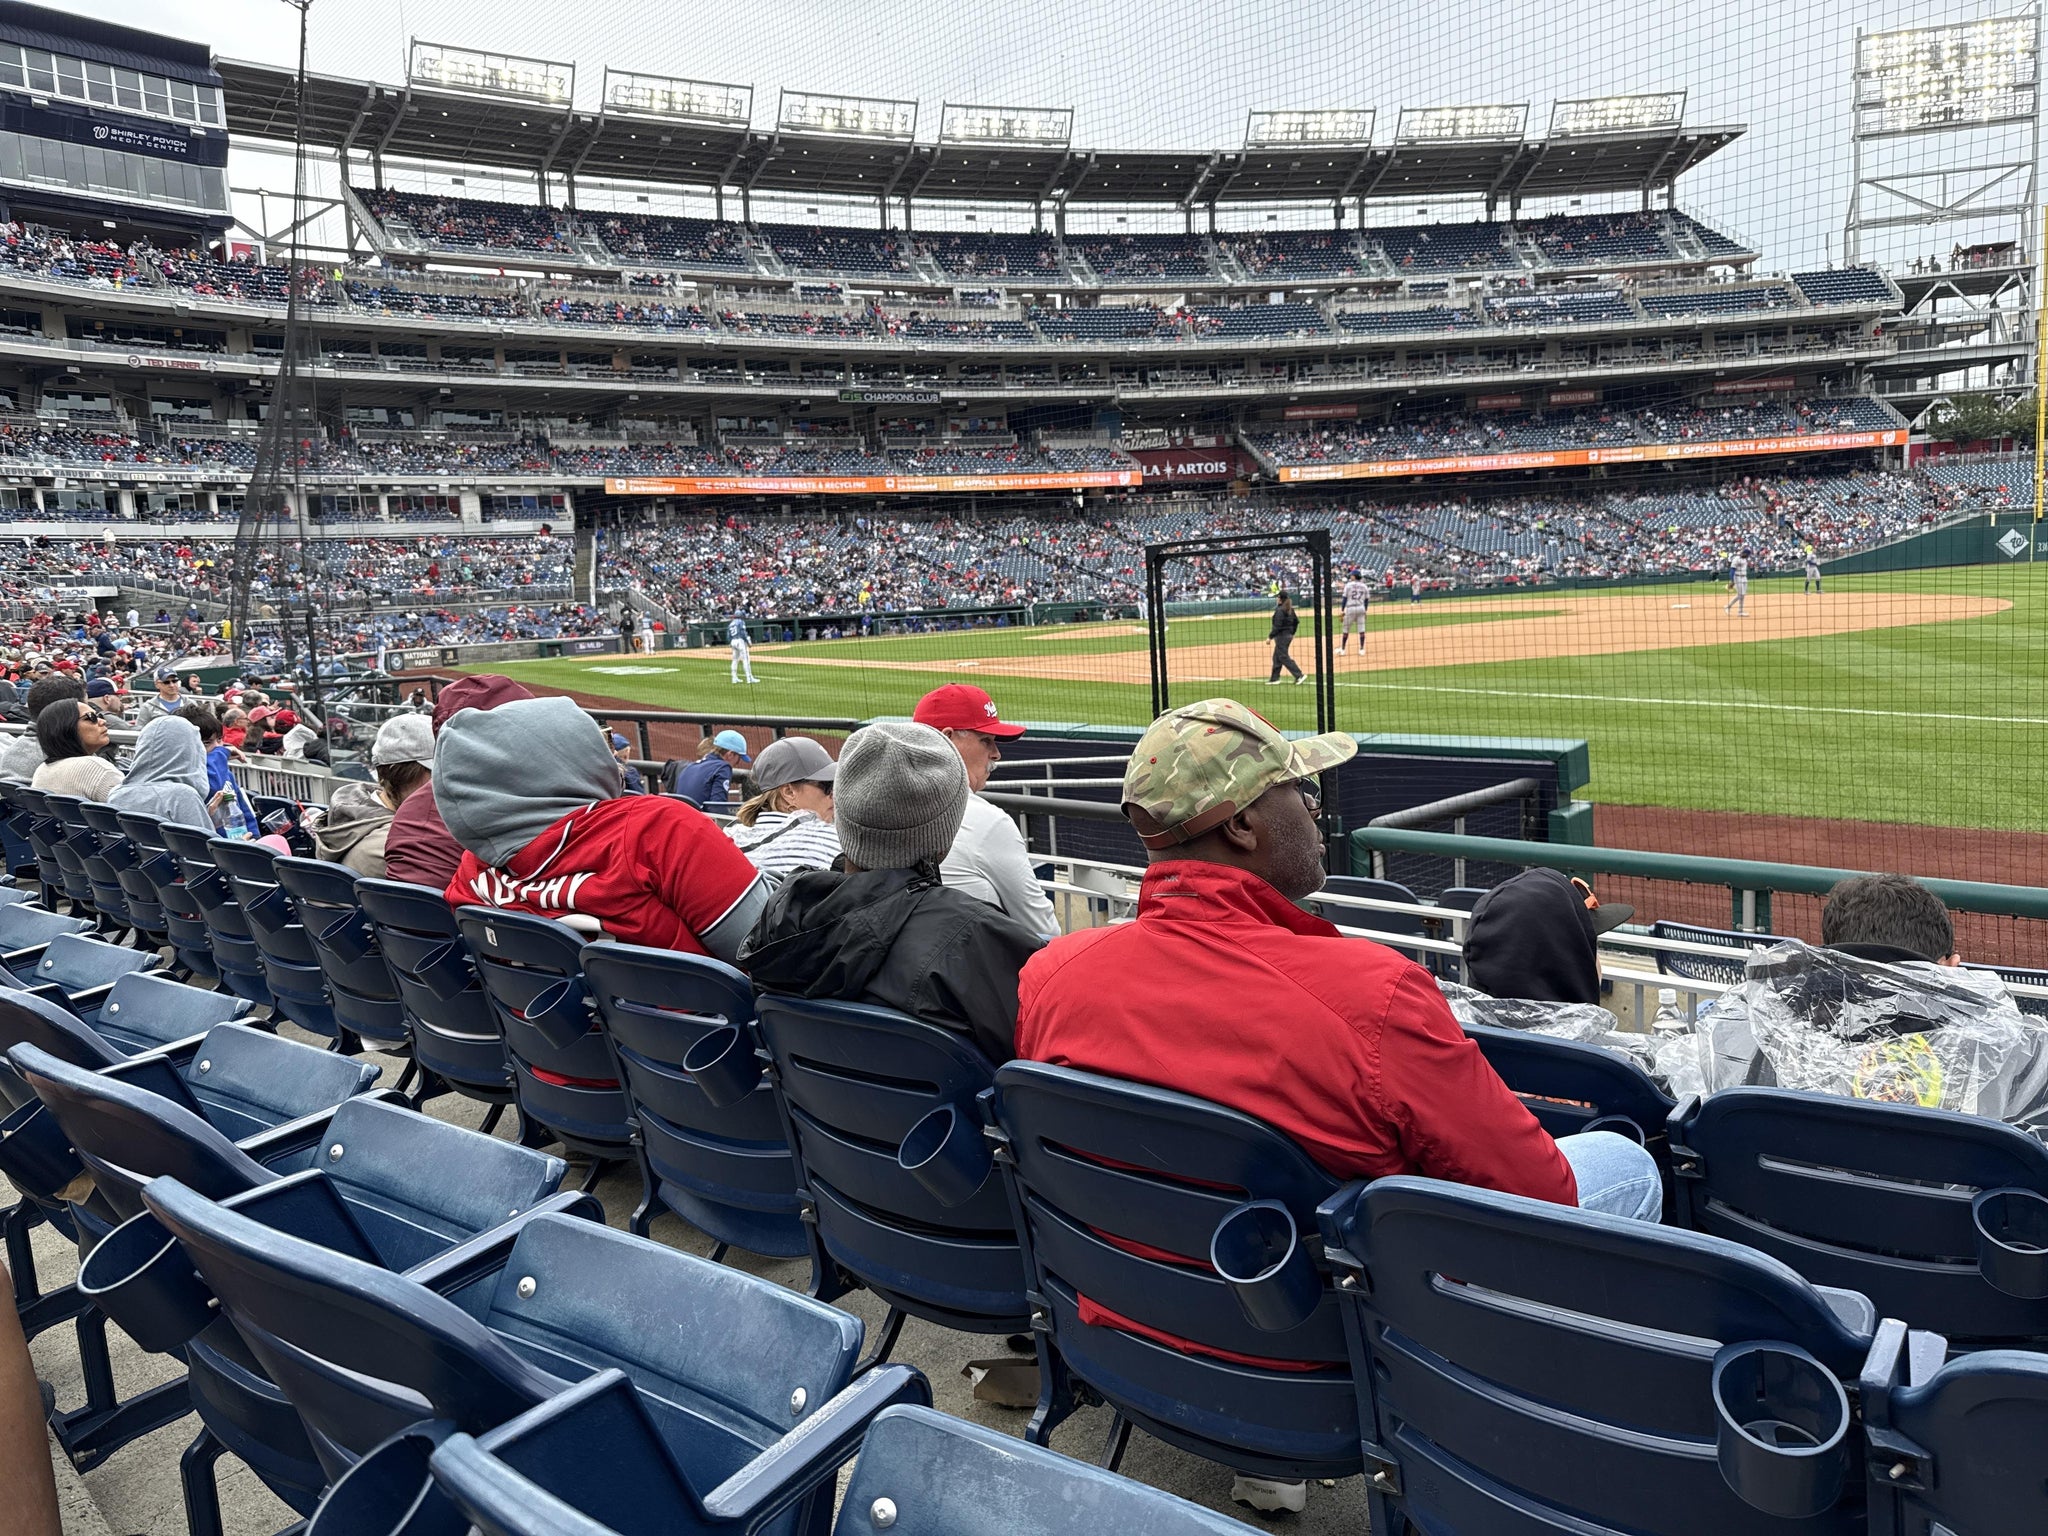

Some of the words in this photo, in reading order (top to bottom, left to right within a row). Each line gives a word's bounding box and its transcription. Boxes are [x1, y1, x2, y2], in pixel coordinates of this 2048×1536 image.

[110, 128, 150, 140] SHIRLEY
[152, 136, 187, 147] POVICH
[110, 136, 142, 145] MEDIA
[146, 142, 187, 153] CENTER
[166, 360, 200, 370] LERNER
[864, 393, 914, 401] CHAMPIONS
[916, 394, 938, 402] CLUB
[1666, 447, 1680, 455] AN
[1684, 444, 1724, 454] OFFICIAL
[1725, 442, 1755, 452] WASTE
[1780, 438, 1830, 448] RECYCLING
[1833, 436, 1875, 445] PARTNER
[1412, 462, 1456, 470] STANDARD
[1470, 458, 1497, 467] WASTE
[1508, 455, 1555, 465] RECYCLING
[1142, 465, 1160, 476] LA
[1177, 462, 1227, 474] ARTOIS
[1041, 476, 1080, 484] RECYCLING
[1352, 591, 1364, 600] 27
[404, 650, 439, 660] NATIONALS
